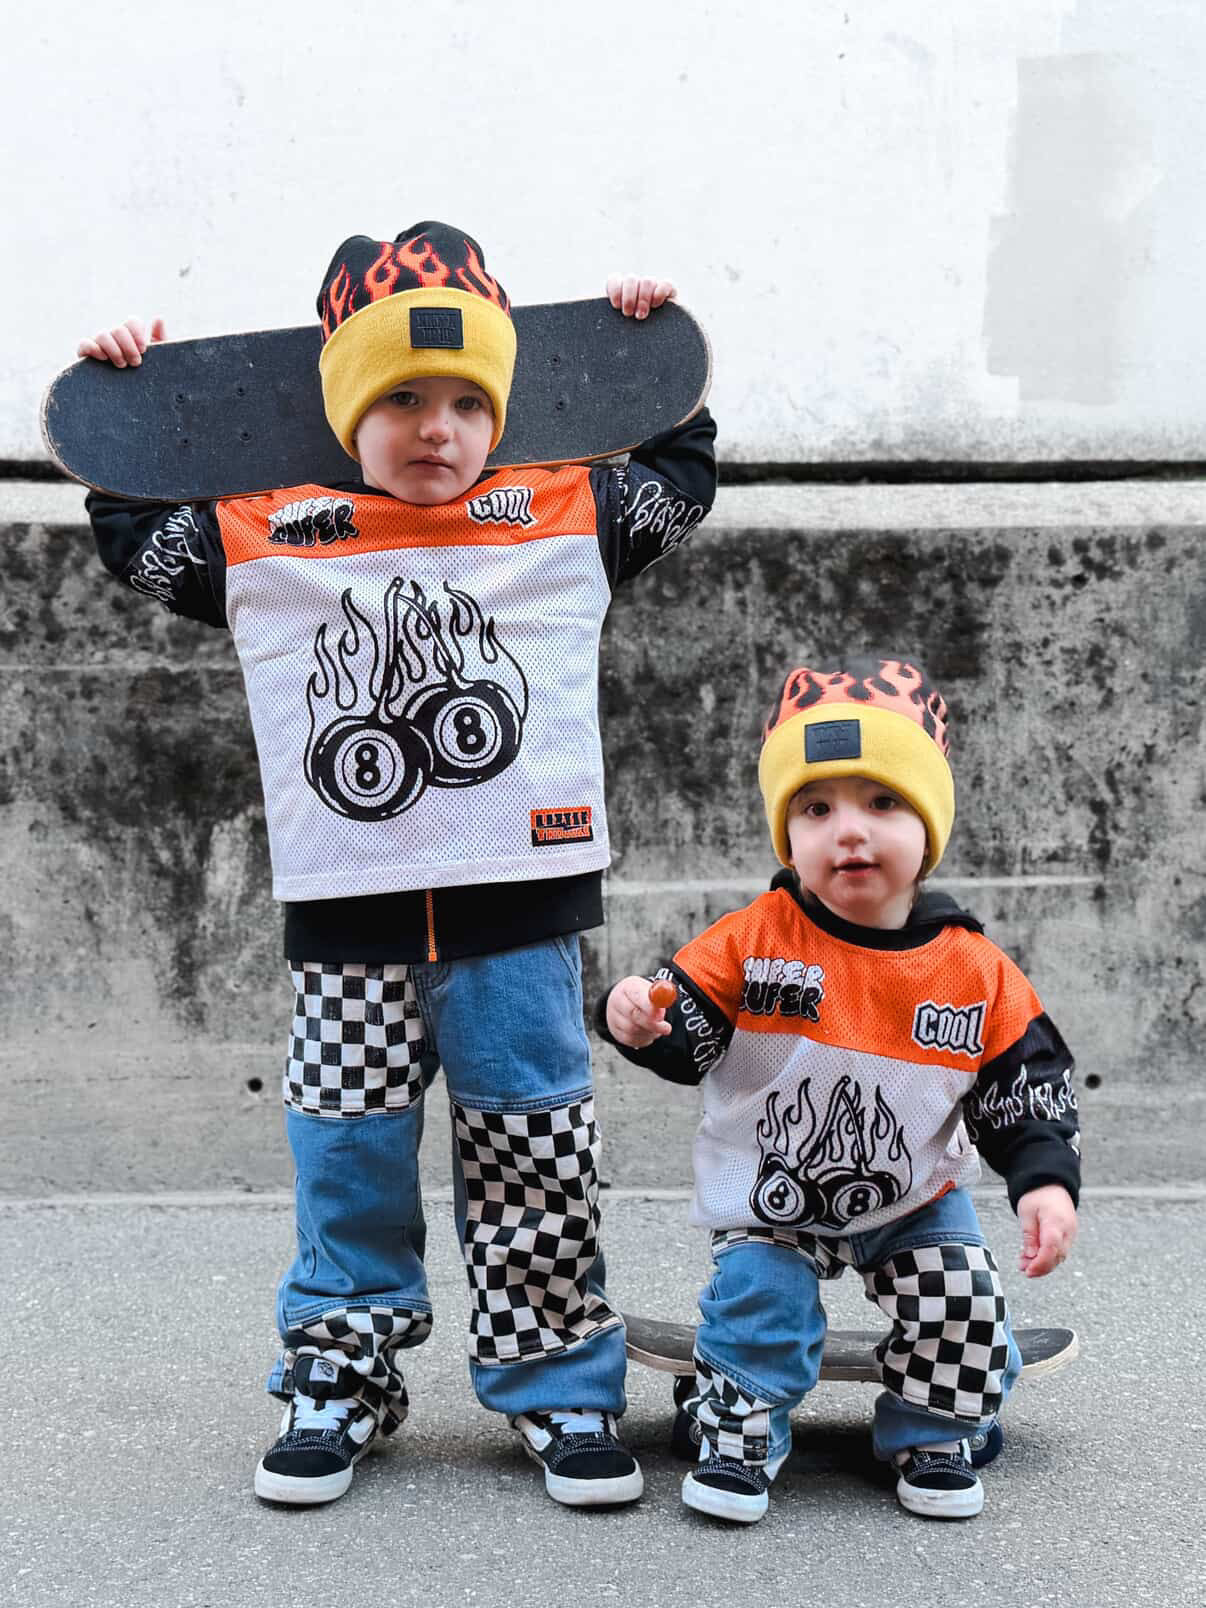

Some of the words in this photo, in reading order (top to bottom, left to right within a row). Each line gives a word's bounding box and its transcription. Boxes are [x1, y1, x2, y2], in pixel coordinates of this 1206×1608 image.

[453, 706, 486, 755] 8
[355, 743, 381, 790] 8
[768, 1181, 789, 1210] 8
[846, 1187, 872, 1217] 8
